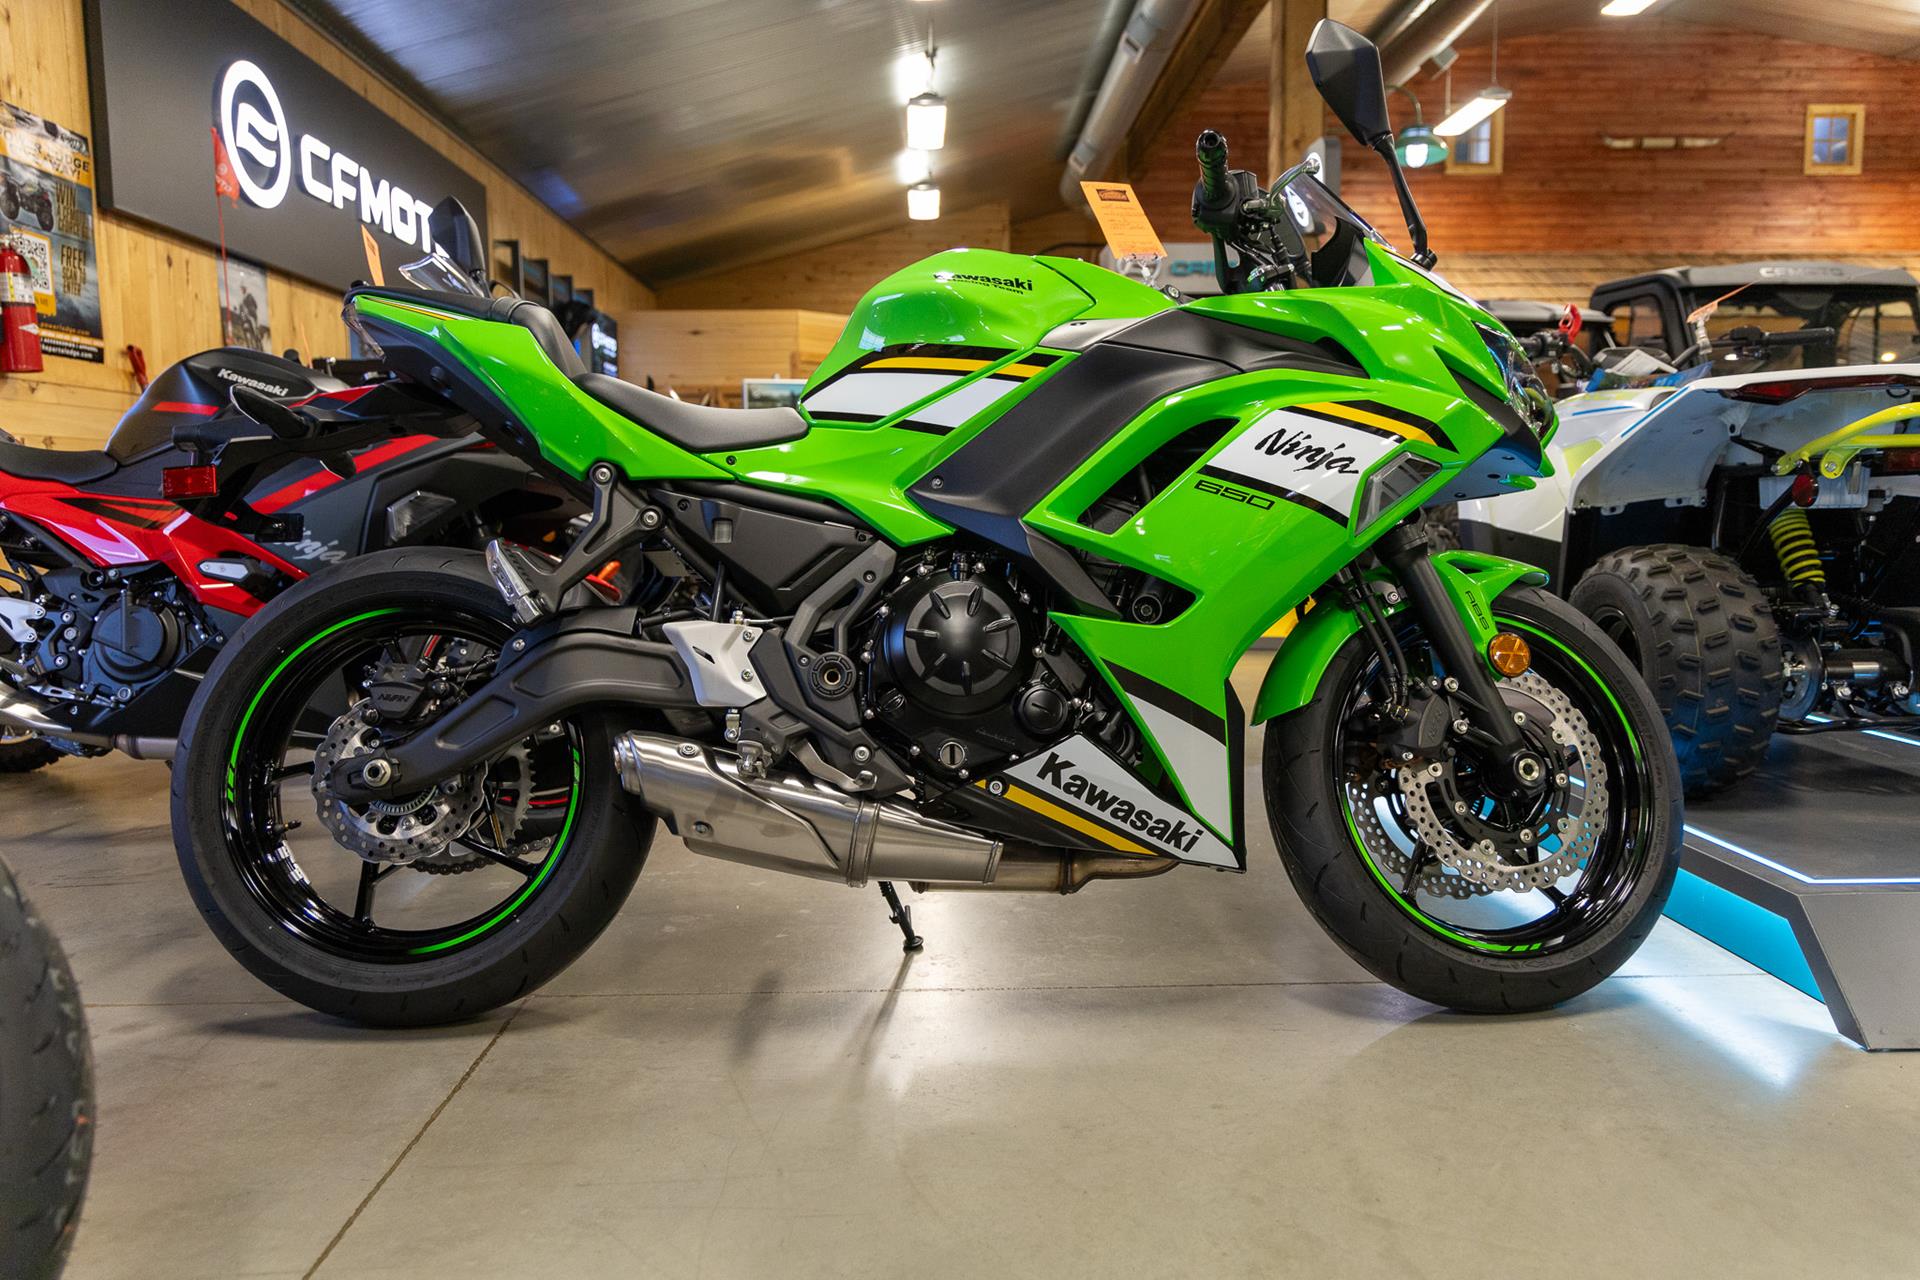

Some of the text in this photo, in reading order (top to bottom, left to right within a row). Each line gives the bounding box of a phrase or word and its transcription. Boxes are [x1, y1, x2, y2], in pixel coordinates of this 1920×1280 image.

[301, 134, 449, 258] CFMOT
[61, 245, 86, 269] FREE!
[217, 368, 289, 397] Kawasaki
[1254, 428, 1359, 474] Ninja
[1194, 479, 1276, 511] 650
[1465, 590, 1490, 630] ABS
[1036, 751, 1204, 853] Kawasaki
